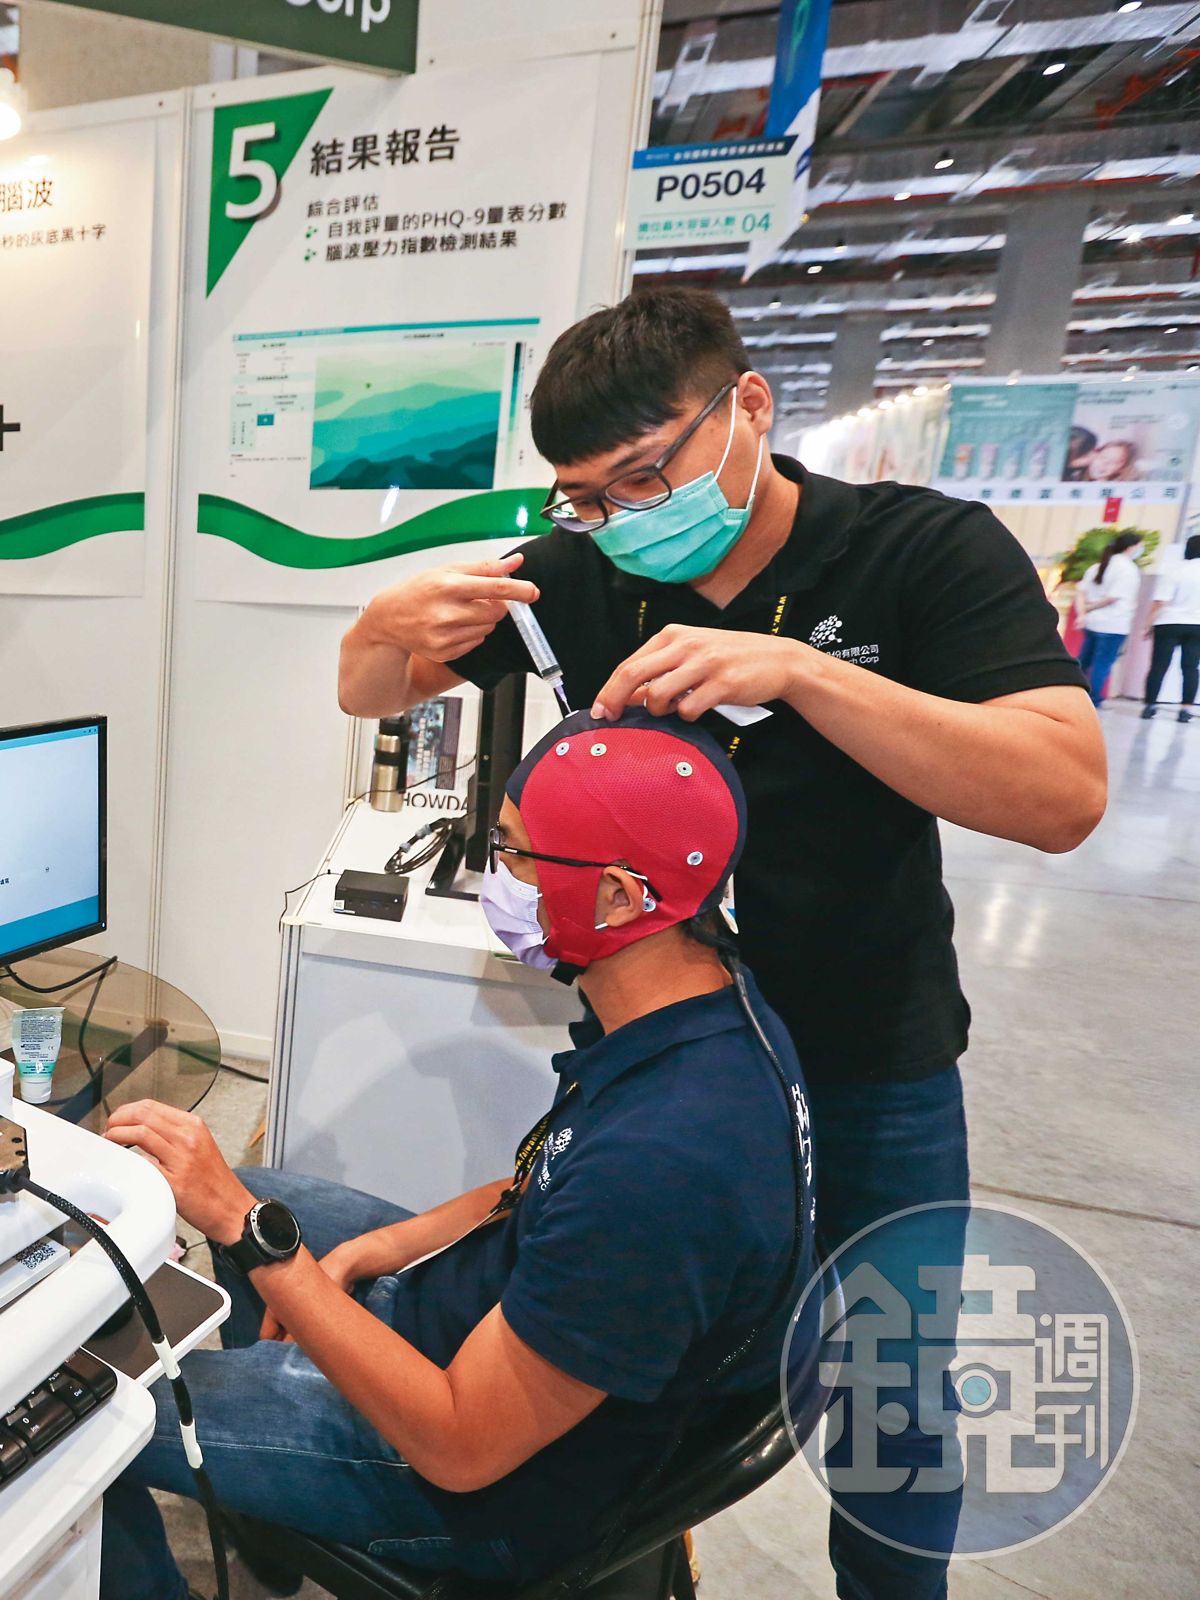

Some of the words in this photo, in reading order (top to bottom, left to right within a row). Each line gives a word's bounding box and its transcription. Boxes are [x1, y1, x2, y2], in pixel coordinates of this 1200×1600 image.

[310, 125, 460, 176] 結果報告
[226, 122, 278, 220] 5
[656, 167, 766, 202] P0504
[308, 195, 379, 218] 綜合評估
[328, 202, 566, 238] 自我評量的PHQ-9量表分數
[741, 212, 771, 233] 04
[326, 230, 517, 262] 腦波壓力指數檢測結果
[860, 656, 879, 664] Corp
